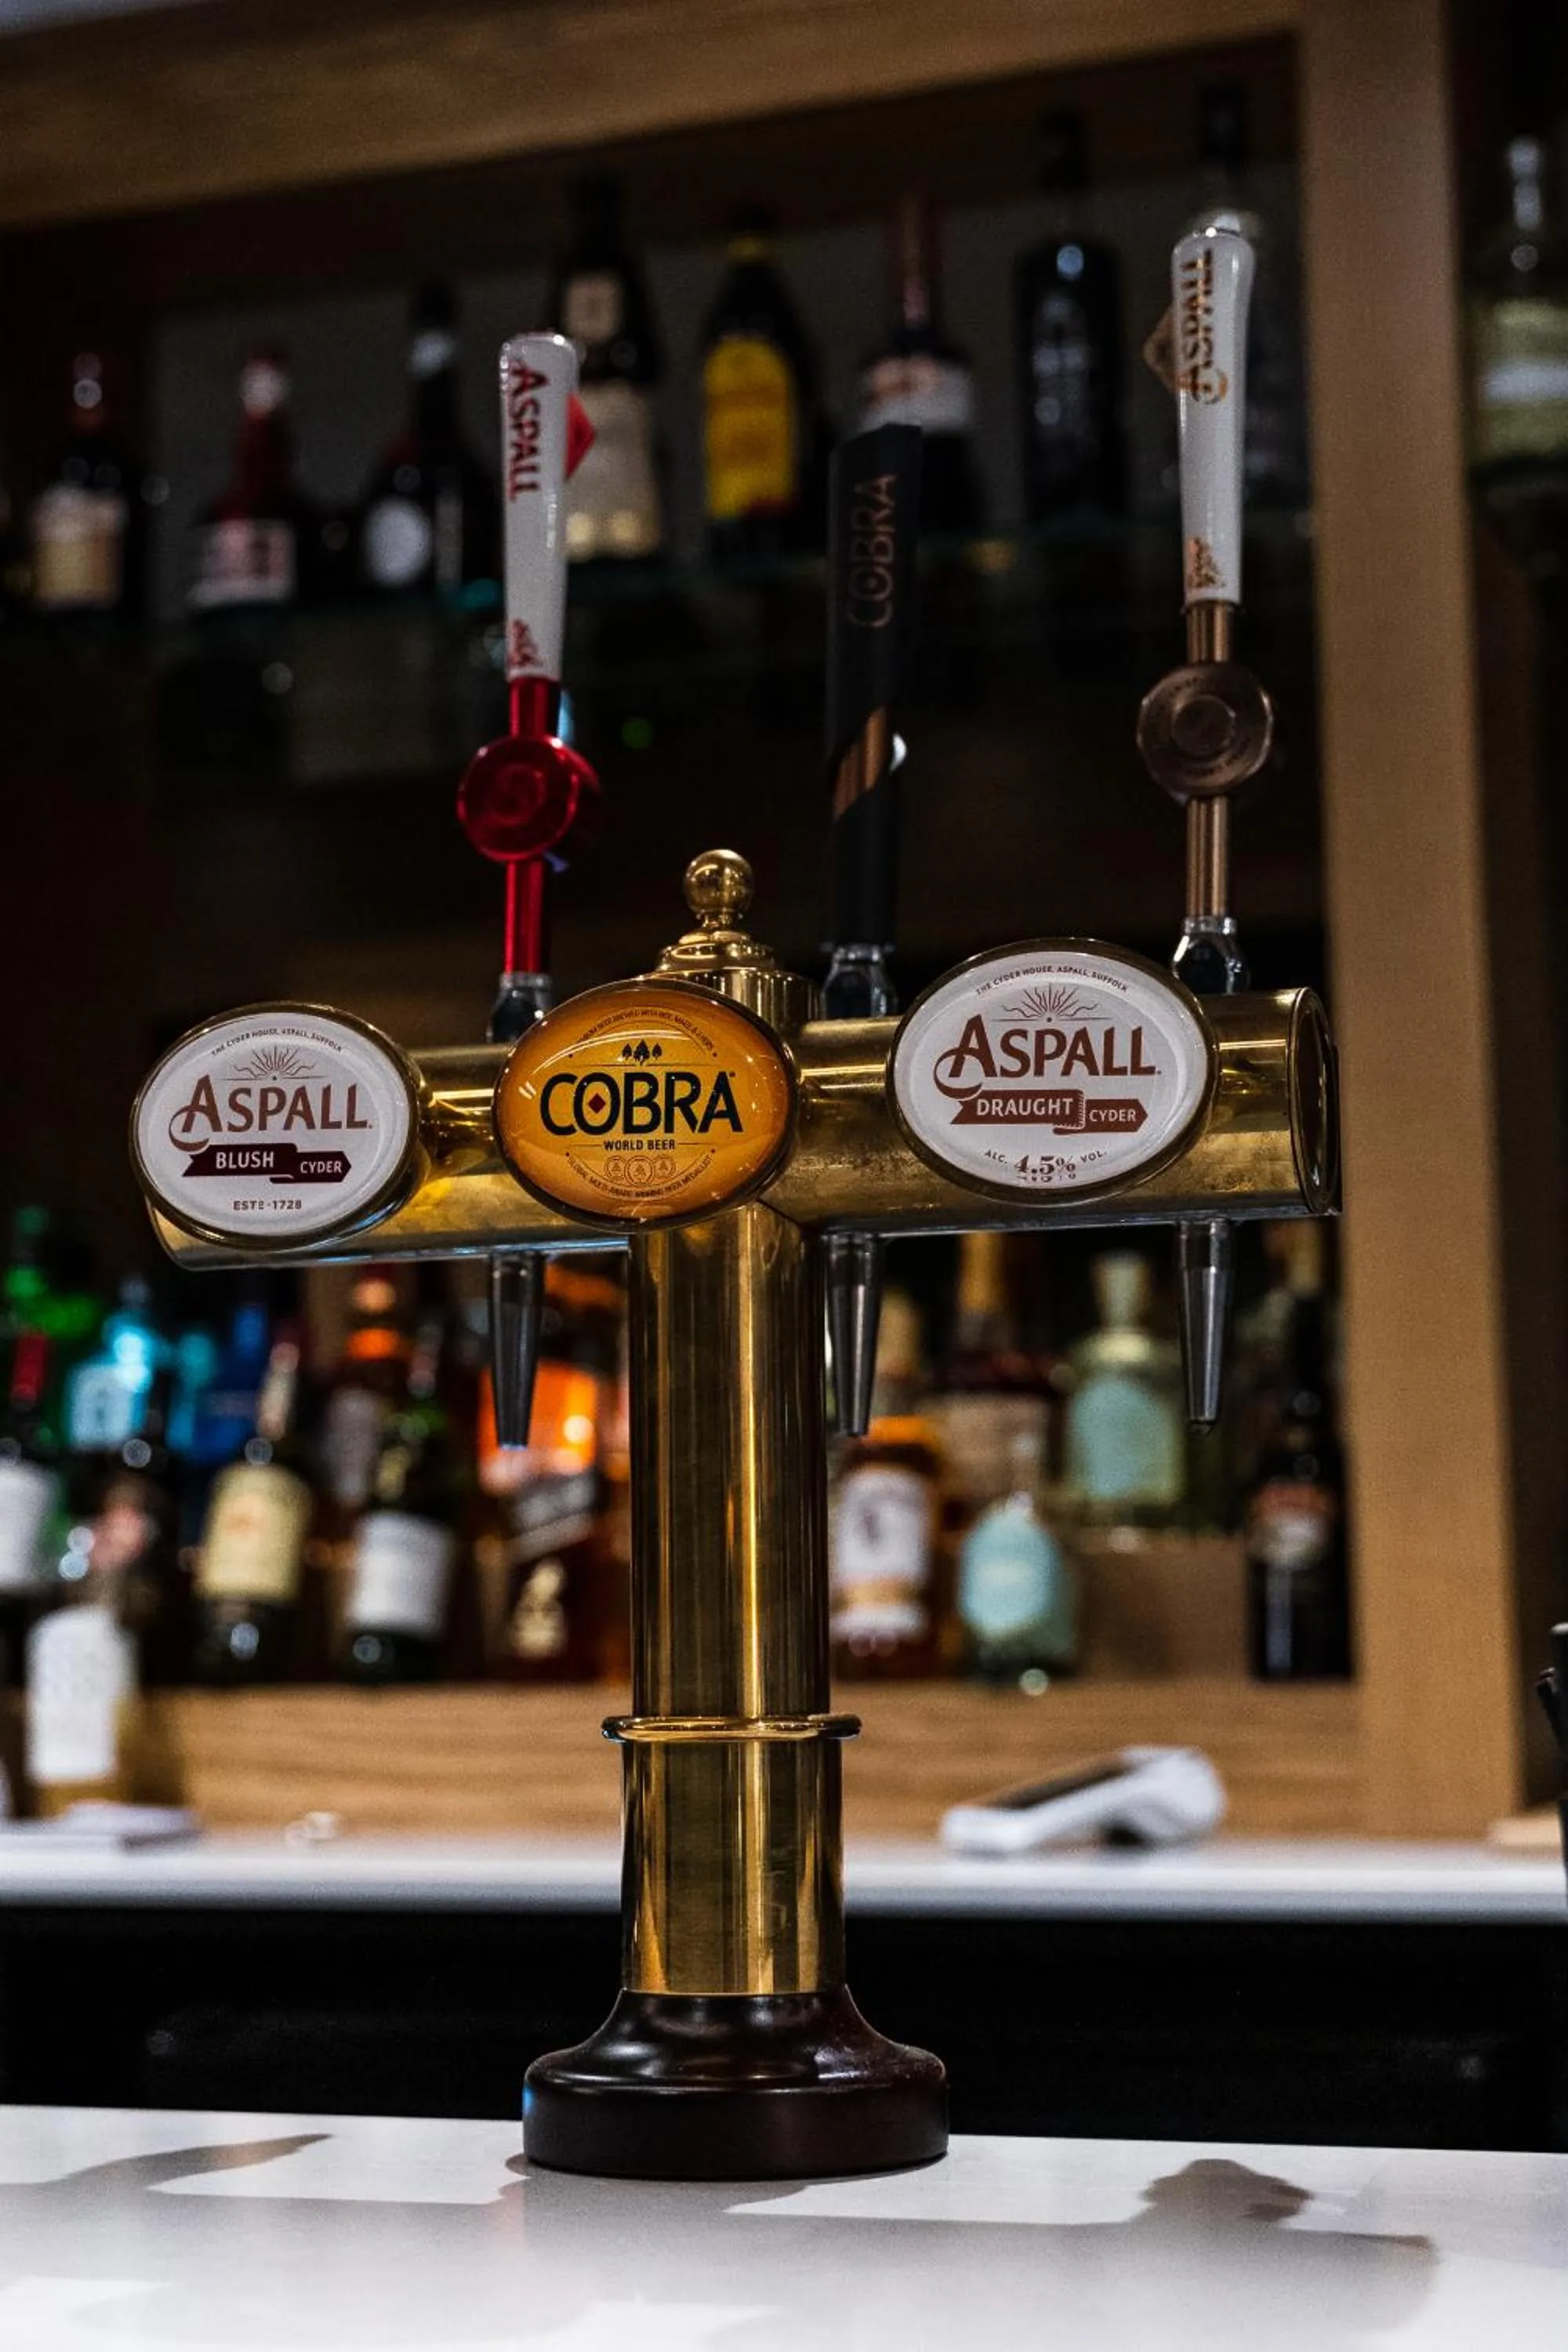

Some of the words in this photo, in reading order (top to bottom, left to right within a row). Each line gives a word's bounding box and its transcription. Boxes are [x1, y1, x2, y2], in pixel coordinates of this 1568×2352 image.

[846, 474, 898, 628] COBRA
[976, 982, 992, 996] THE
[993, 971, 1020, 985] CYDER
[1091, 971, 1129, 993] SUFFOLK
[211, 1045, 226, 1056] THE
[539, 1071, 744, 1136] COBRA
[976, 1098, 1073, 1117] DRAUGHT
[1089, 1109, 1137, 1122] CYDER
[603, 1139, 644, 1151] WORLD
[648, 1139, 676, 1150] BEER
[216, 1151, 274, 1170] BLUSH
[299, 1160, 343, 1174] CYDER
[984, 1149, 1007, 1164] ALC.
[1014, 1155, 1076, 1175] 4.5%
[1080, 1150, 1108, 1163] VOL.
[272, 1199, 302, 1210] 1728
